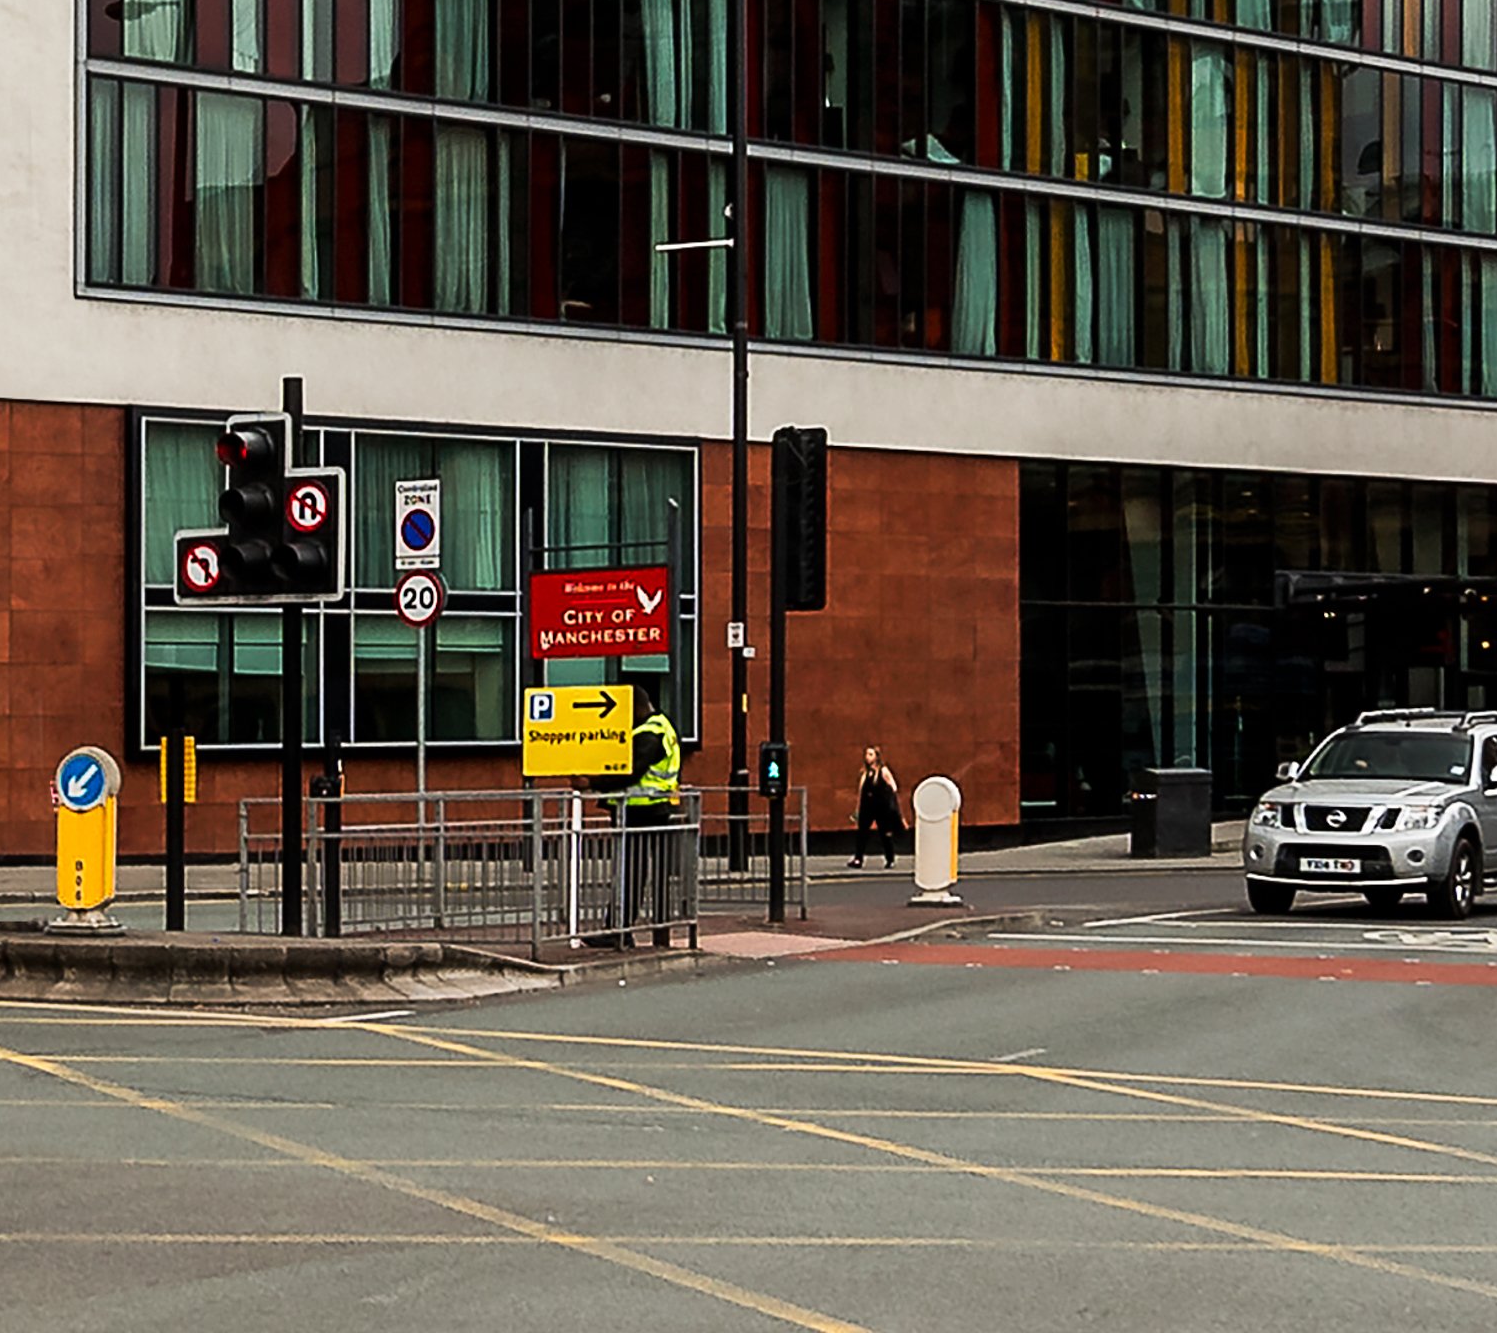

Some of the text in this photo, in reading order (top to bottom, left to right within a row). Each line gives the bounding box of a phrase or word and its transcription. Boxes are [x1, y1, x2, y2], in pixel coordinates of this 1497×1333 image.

[404, 494, 432, 506] ZONE
[564, 580, 634, 594] Welcome to the
[403, 585, 435, 610] 20
[539, 627, 661, 646] MANCHESTER
[528, 728, 627, 745] Shopper parking
